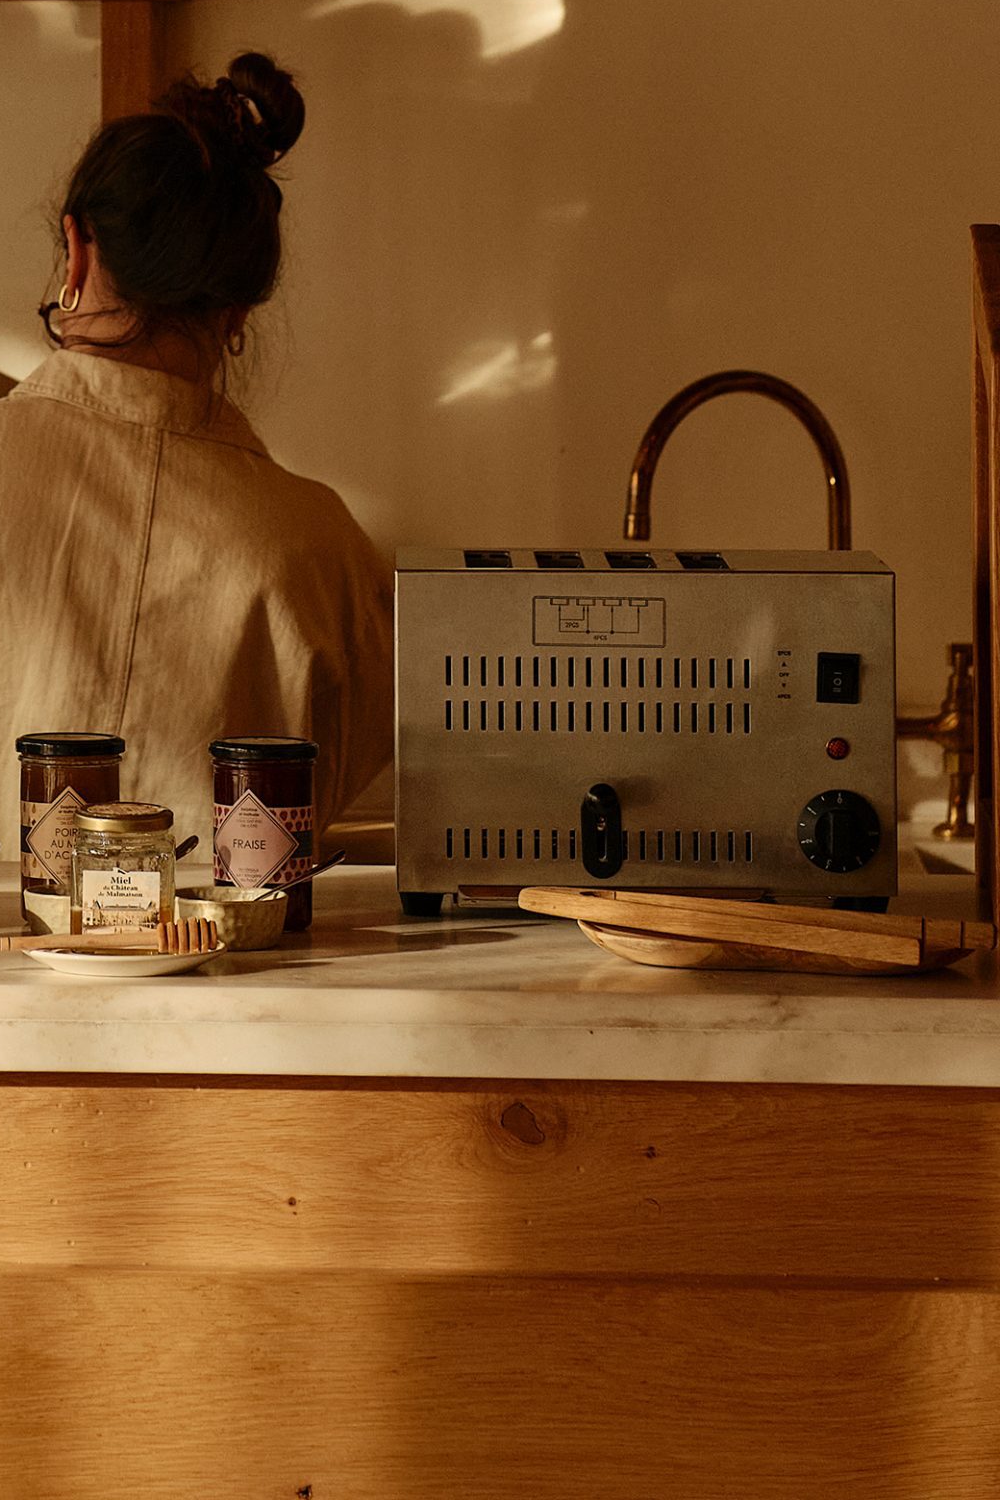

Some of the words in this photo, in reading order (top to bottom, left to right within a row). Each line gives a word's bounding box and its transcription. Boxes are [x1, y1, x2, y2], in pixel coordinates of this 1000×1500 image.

[55, 828, 80, 837] POIR
[50, 840, 63, 848] AU
[232, 839, 267, 850] FRAISE
[110, 876, 131, 884] Miel
